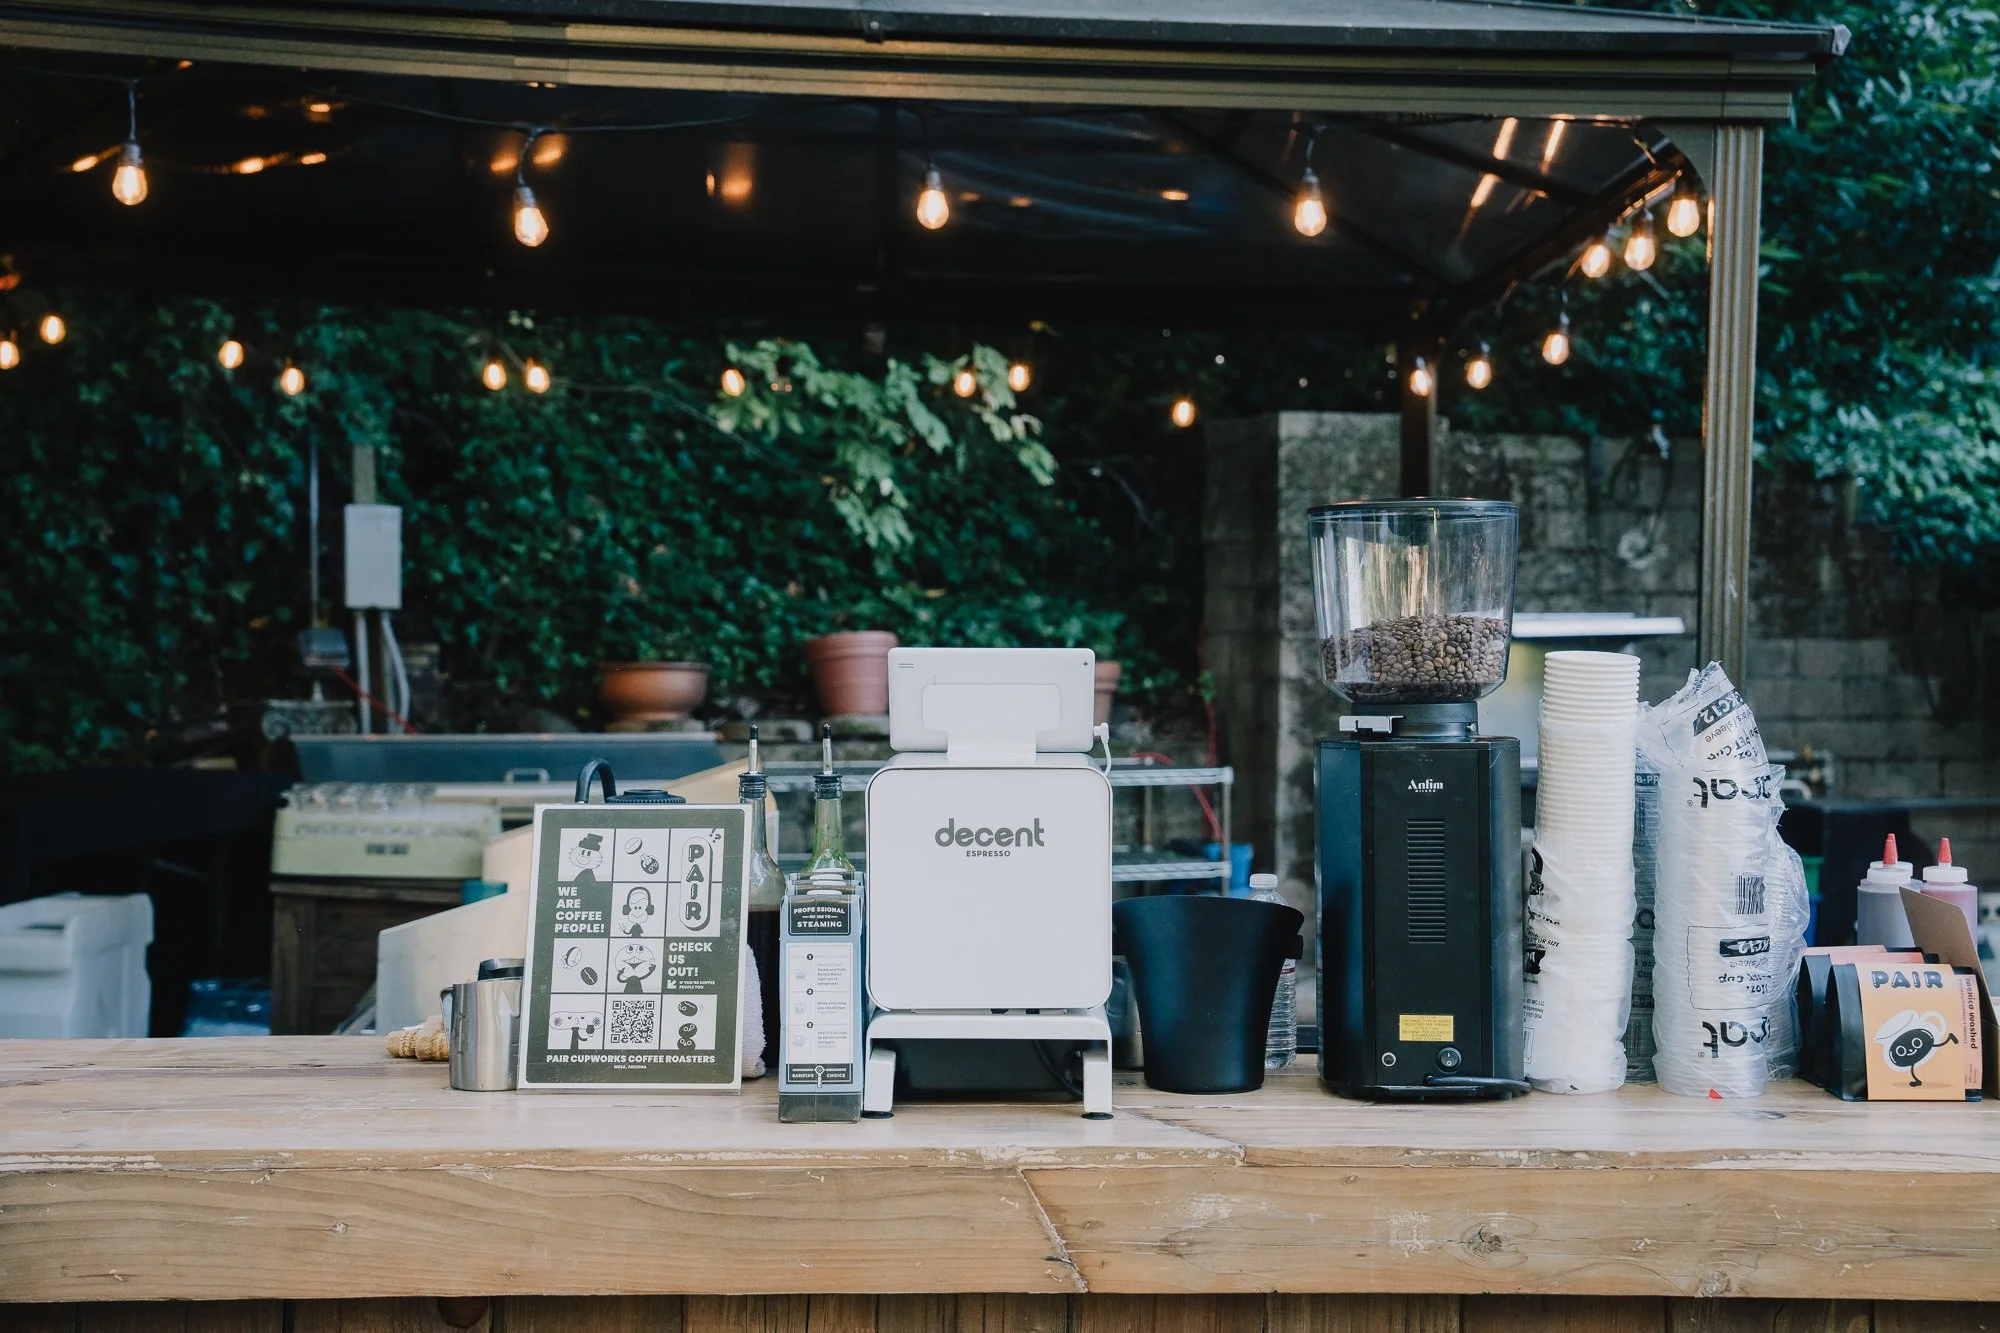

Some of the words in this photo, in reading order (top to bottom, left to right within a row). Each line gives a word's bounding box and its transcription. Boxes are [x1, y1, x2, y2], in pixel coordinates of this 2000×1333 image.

[935, 818, 1045, 847] decent
[686, 844, 705, 920] PAIR
[557, 887, 578, 896] WE
[556, 899, 581, 908] ARE
[793, 906, 846, 914] PROFESSIONAL
[555, 911, 602, 920] COFFEE
[554, 923, 605, 933] PEOPLE!
[669, 942, 713, 952] CHECK
[668, 955, 685, 964] US
[668, 967, 698, 977] OUT!
[1871, 970, 1943, 988] PAIR
[1969, 1012, 1978, 1049] washed
[546, 1055, 569, 1063] PAIR
[570, 1055, 627, 1063] CUPWORKS
[628, 1055, 664, 1063] COFFEE
[665, 1055, 716, 1063] ROASTERS
